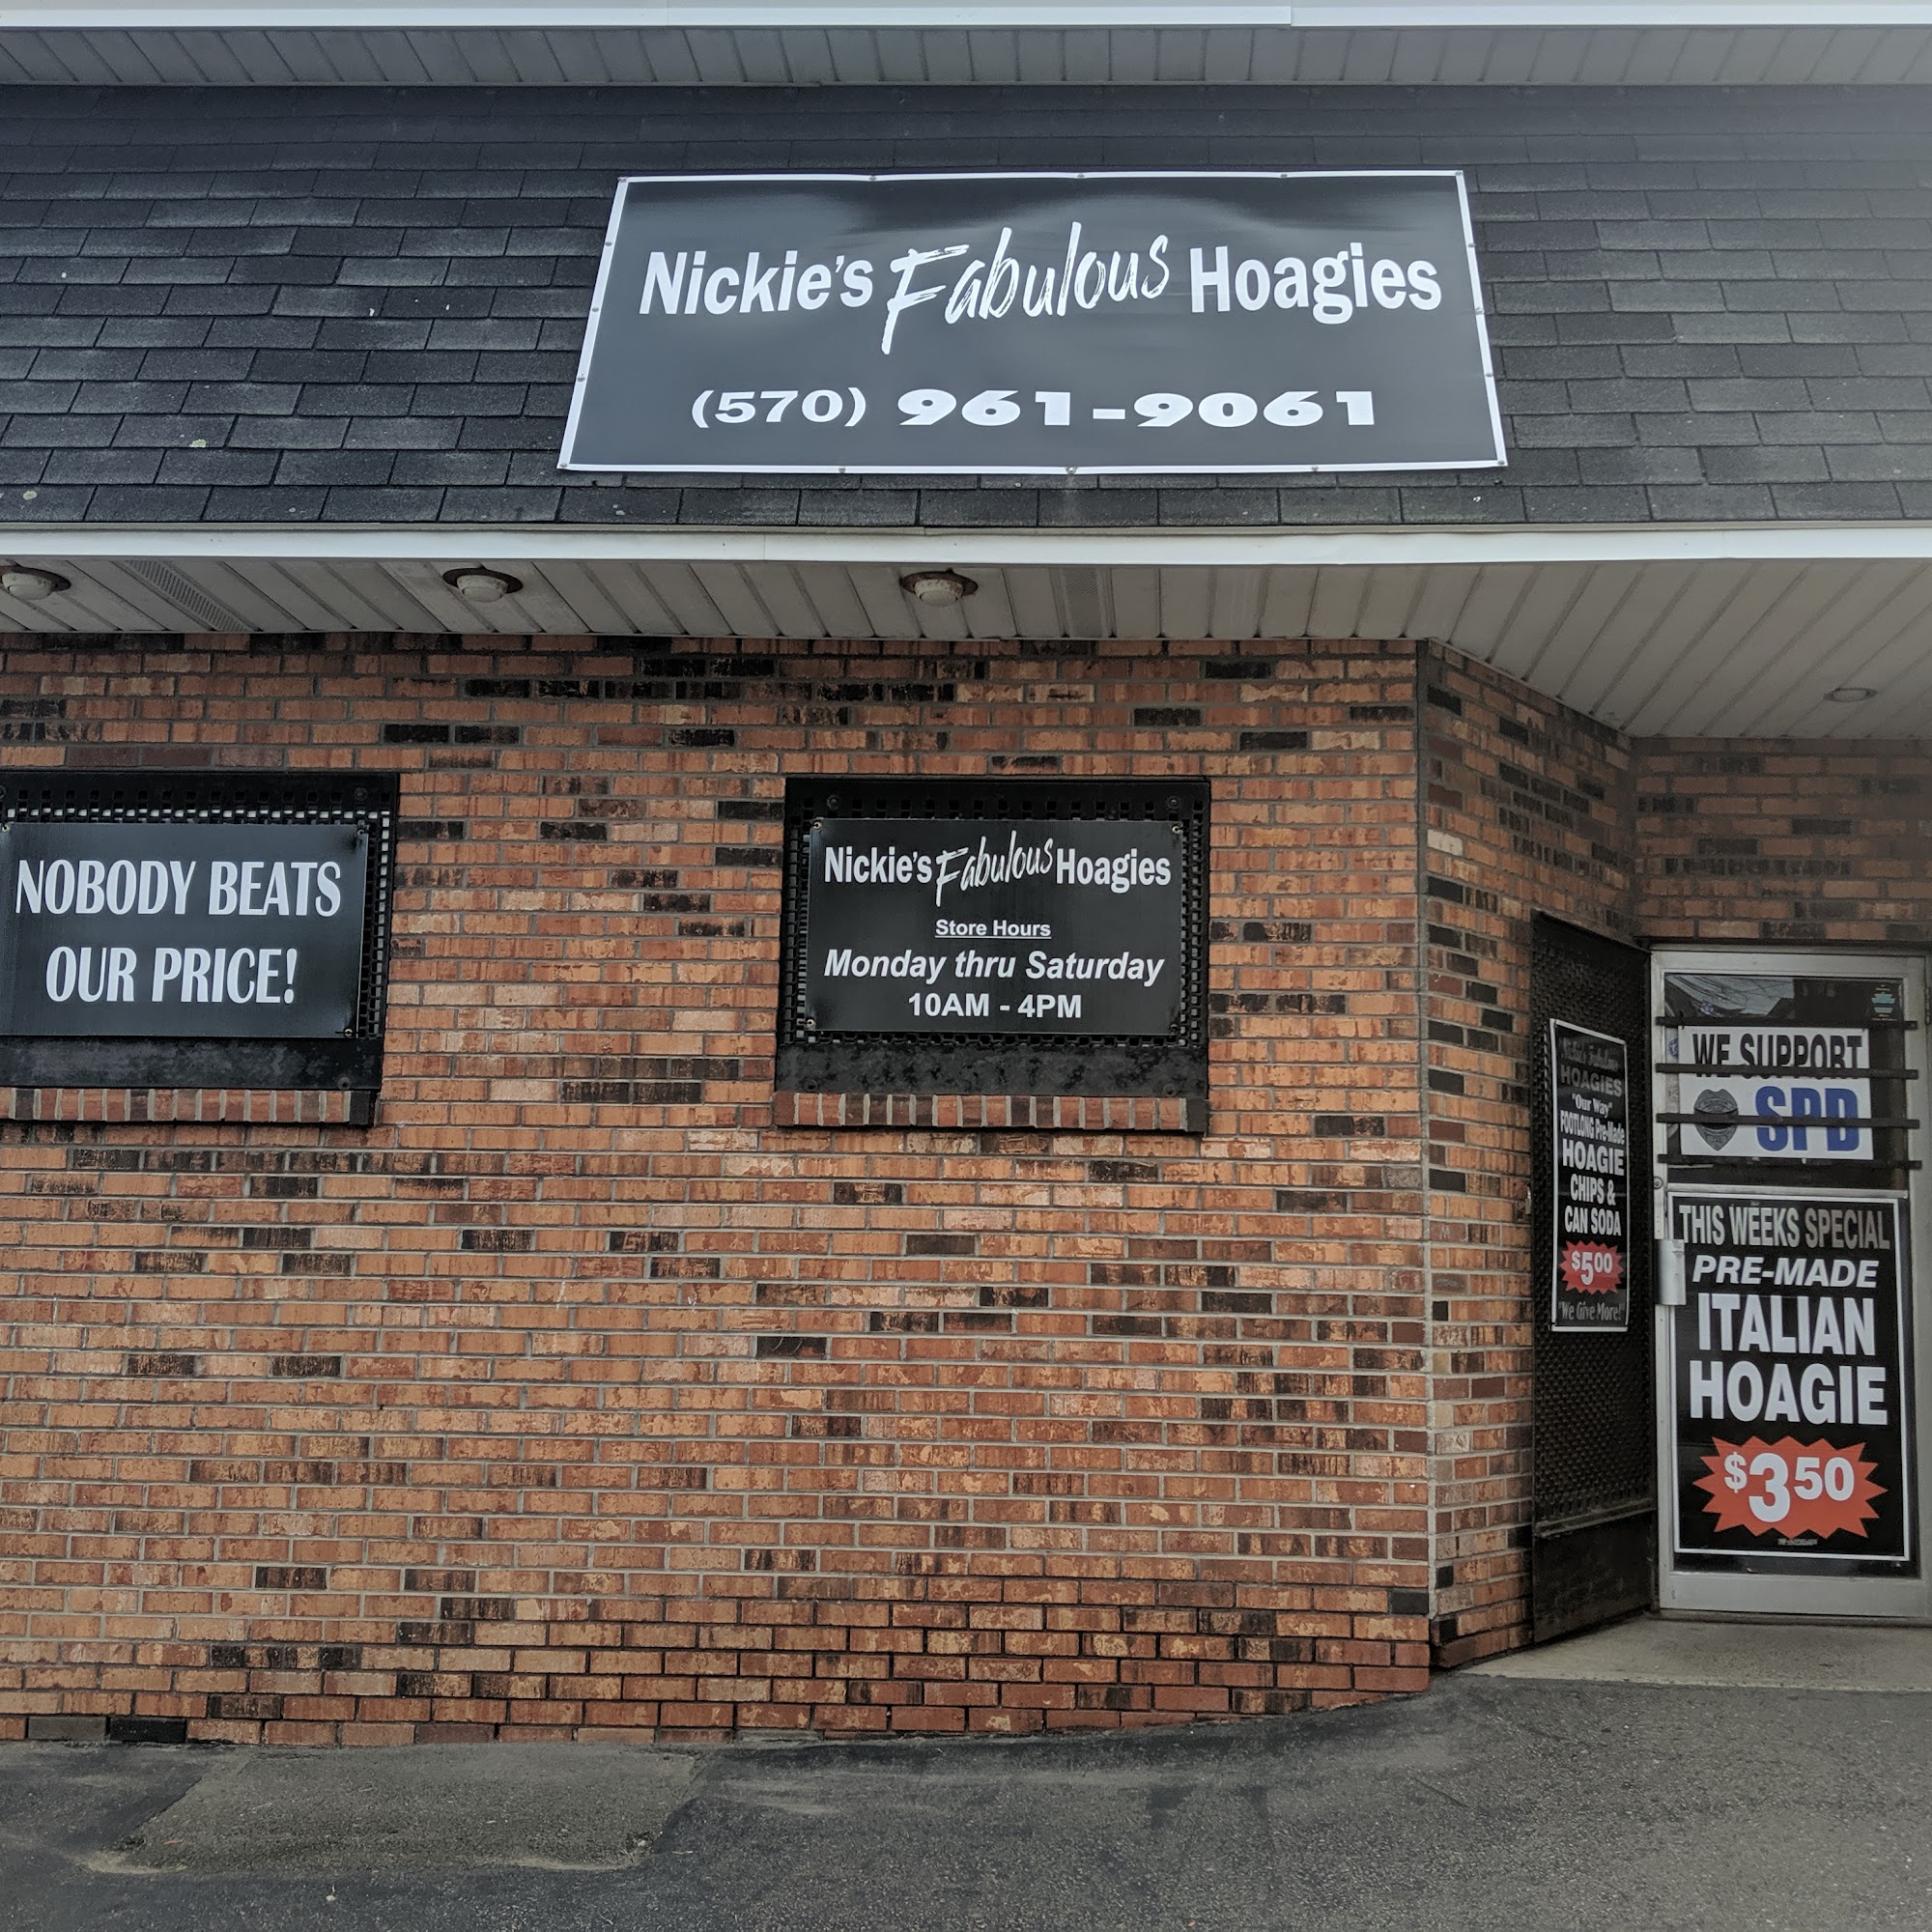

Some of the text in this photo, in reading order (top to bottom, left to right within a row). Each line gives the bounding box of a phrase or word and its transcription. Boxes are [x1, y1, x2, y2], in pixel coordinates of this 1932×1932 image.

[639, 220, 1442, 355] Nickie's Fabulous Hoagies
[691, 387, 1376, 430] (570) 961-9061
[15, 859, 341, 917] NOBODY BEATS
[824, 830, 1171, 907] Nickie's Fabulous Hoagies
[935, 919, 1051, 938] Store Hours
[45, 946, 298, 1005] OUR PRICE!
[824, 949, 1165, 986] Monday thru Saturday
[907, 993, 990, 1017] 10AM
[1017, 994, 1082, 1018] 4PM
[1692, 1033, 1862, 1080] WE SUPPORT
[1560, 1065, 1622, 1097] HOAGIES
[1560, 1109, 1594, 1139] FOOTLONG
[1754, 1086, 1860, 1151] SPD
[1562, 1138, 1625, 1177] HOAGIE
[1570, 1174, 1616, 1207] CHIPS &
[1565, 1206, 1621, 1236] CAN SODA
[1679, 1205, 1890, 1250] THIS WEEKS SPECIAL
[1692, 1255, 1879, 1289] PRE-MADE
[1697, 1293, 1876, 1356] ITALIAN
[1689, 1360, 1889, 1426] HOAGIE
